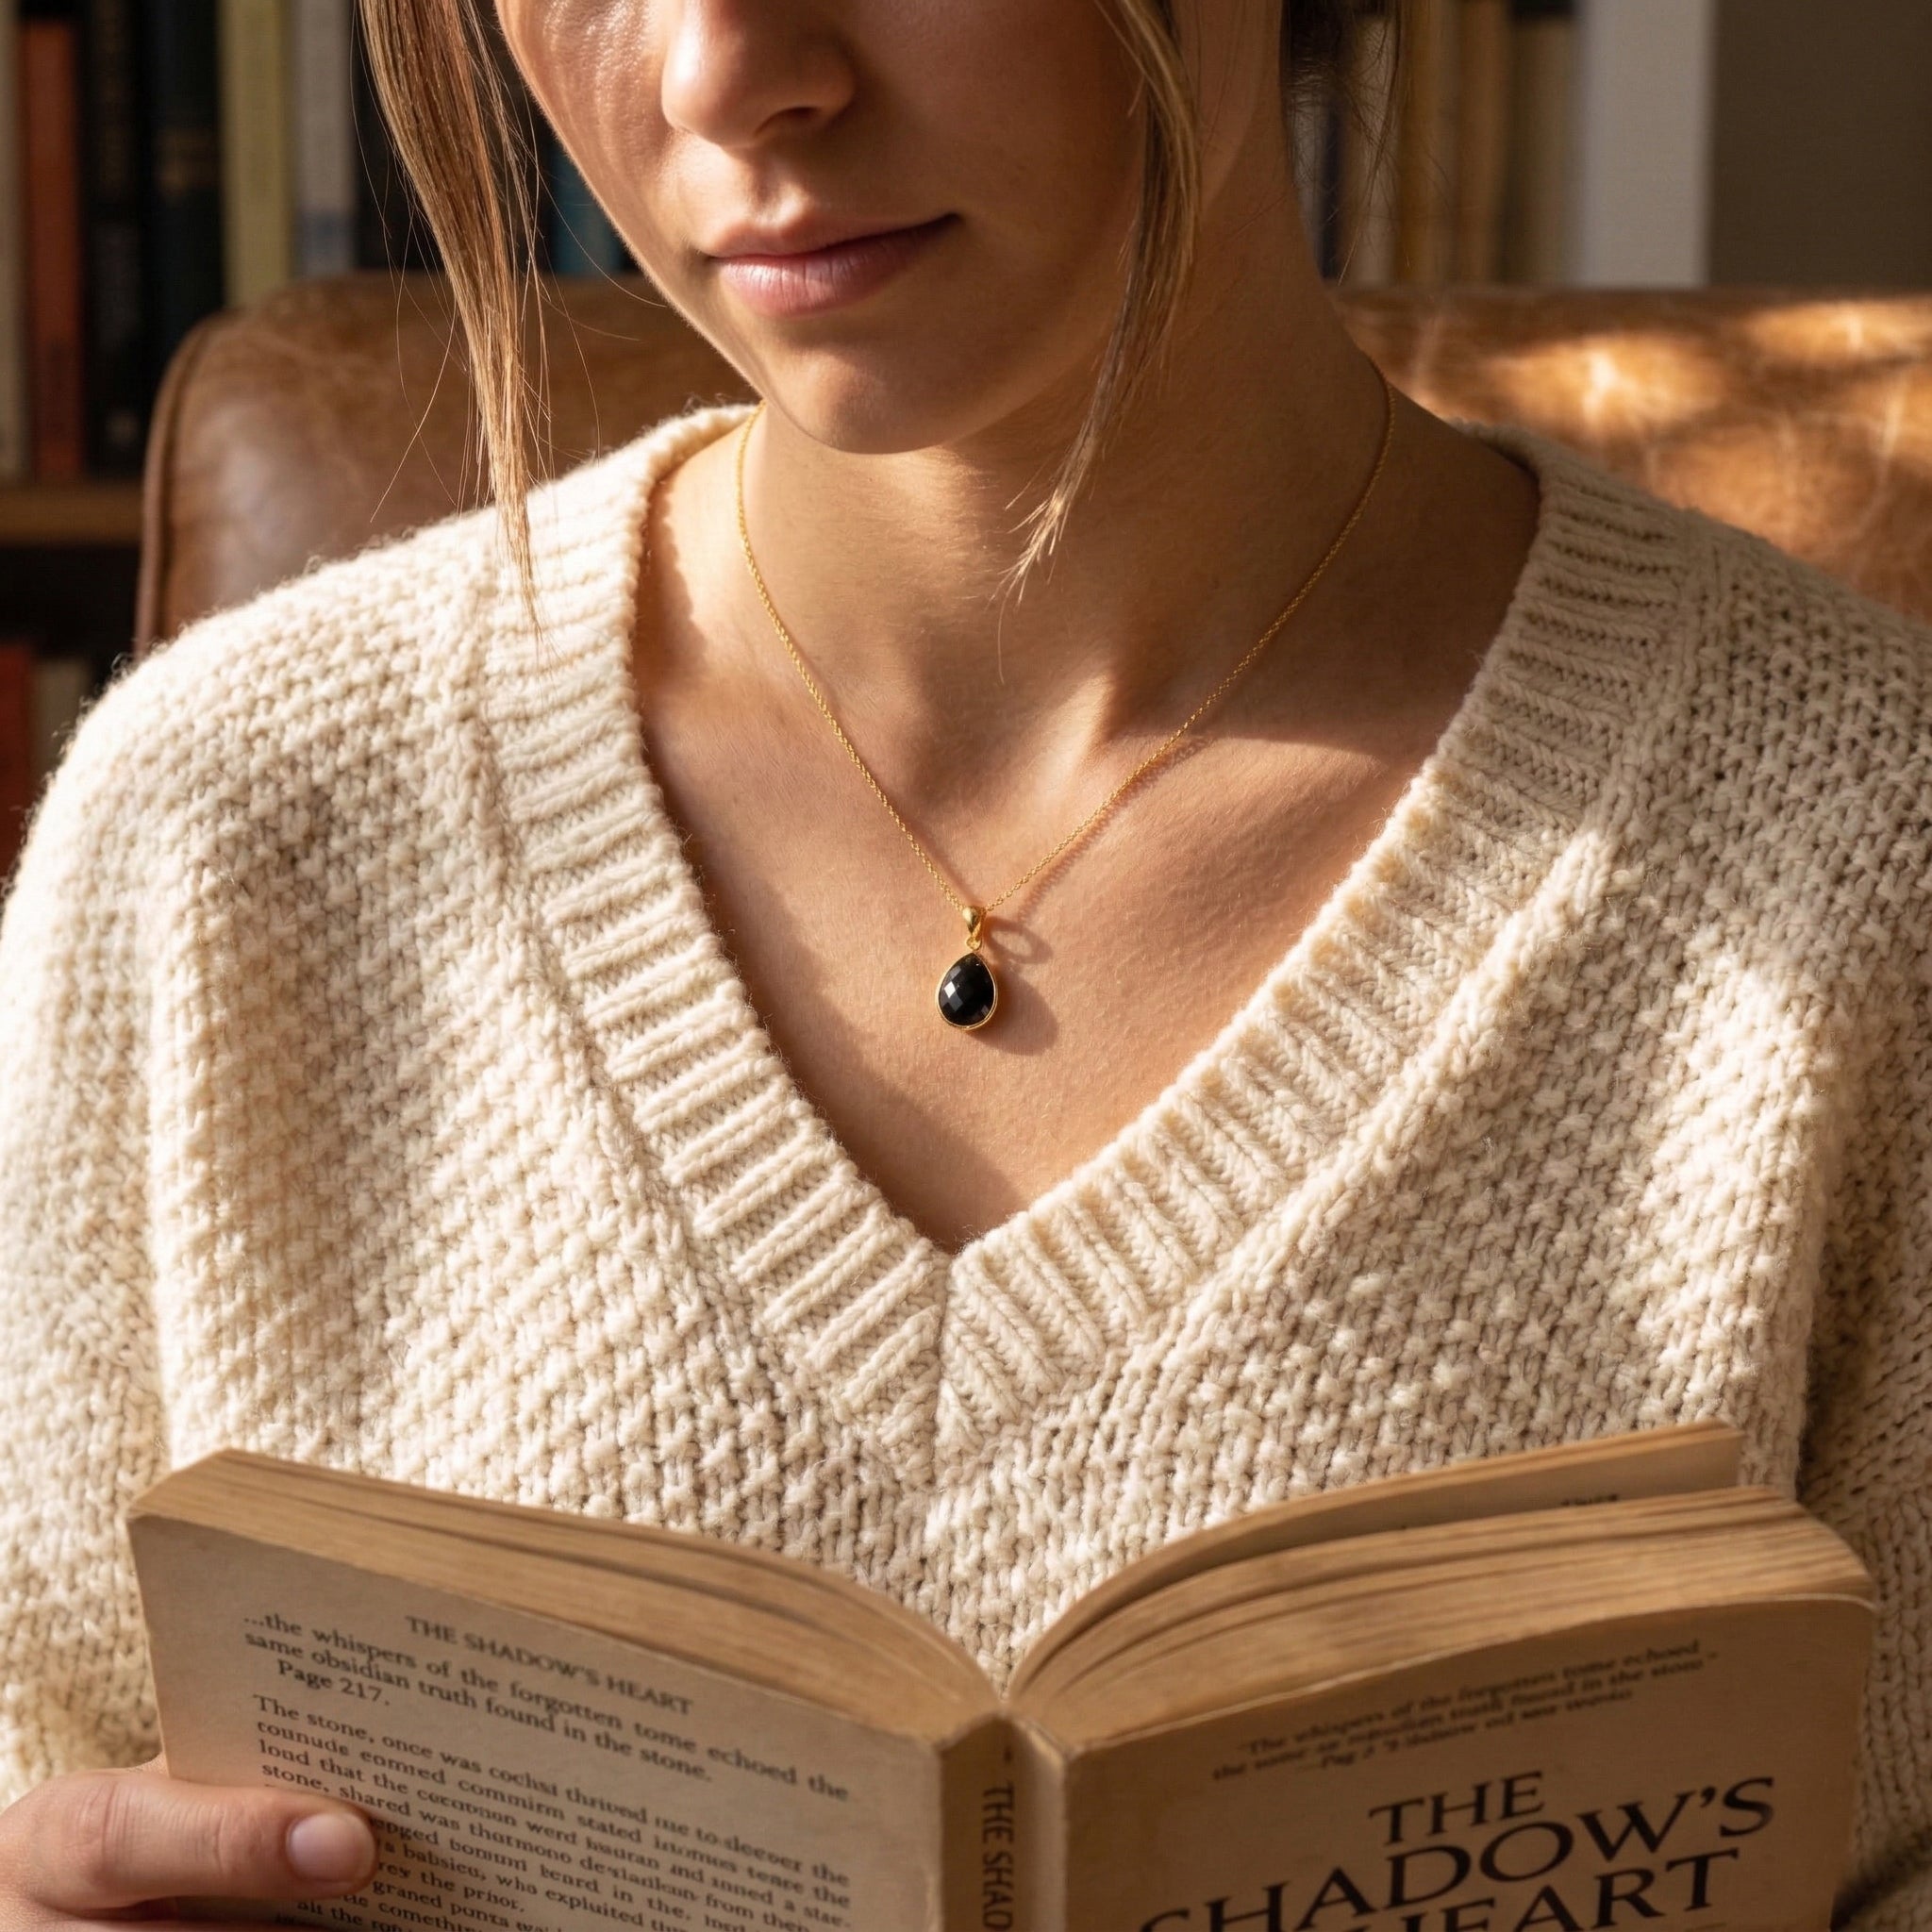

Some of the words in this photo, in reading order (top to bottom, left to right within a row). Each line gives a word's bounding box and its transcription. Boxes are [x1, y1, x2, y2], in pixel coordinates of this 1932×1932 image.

[277, 1658, 332, 1690] Page
[340, 1677, 390, 1706] 217.
[406, 1615, 458, 1644] THE
[464, 1632, 600, 1687] SHADOW'S
[607, 1675, 693, 1715] HEART
[245, 1632, 304, 1658] same
[311, 1650, 409, 1690] obsidian
[419, 1680, 477, 1709] truth
[486, 1697, 556, 1733] found
[564, 1721, 586, 1742] in
[594, 1731, 632, 1757] the
[311, 1629, 417, 1669] whispers
[426, 1659, 452, 1678] of
[460, 1669, 498, 1692] the
[510, 1681, 622, 1730] forgotten
[635, 1723, 696, 1753] tome
[708, 1748, 797, 1785] echoed
[808, 1774, 848, 1802] the
[253, 1694, 299, 1722] The
[307, 1712, 375, 1744] stone,
[381, 1735, 433, 1759] once
[440, 1752, 481, 1774] was
[812, 1863, 850, 1886] the
[319, 1758, 365, 1782] that
[374, 1773, 408, 1794] the
[983, 1779, 1014, 1843] THE
[1369, 1770, 1545, 1845] THE
[340, 1785, 411, 1817] shared
[418, 1808, 460, 1831] was
[706, 1892, 755, 1921] from
[421, 1871, 456, 1898] the
[496, 1874, 538, 1896] who
[613, 1887, 633, 1904] in
[814, 1886, 851, 1909] the
[331, 1907, 363, 1927] the
